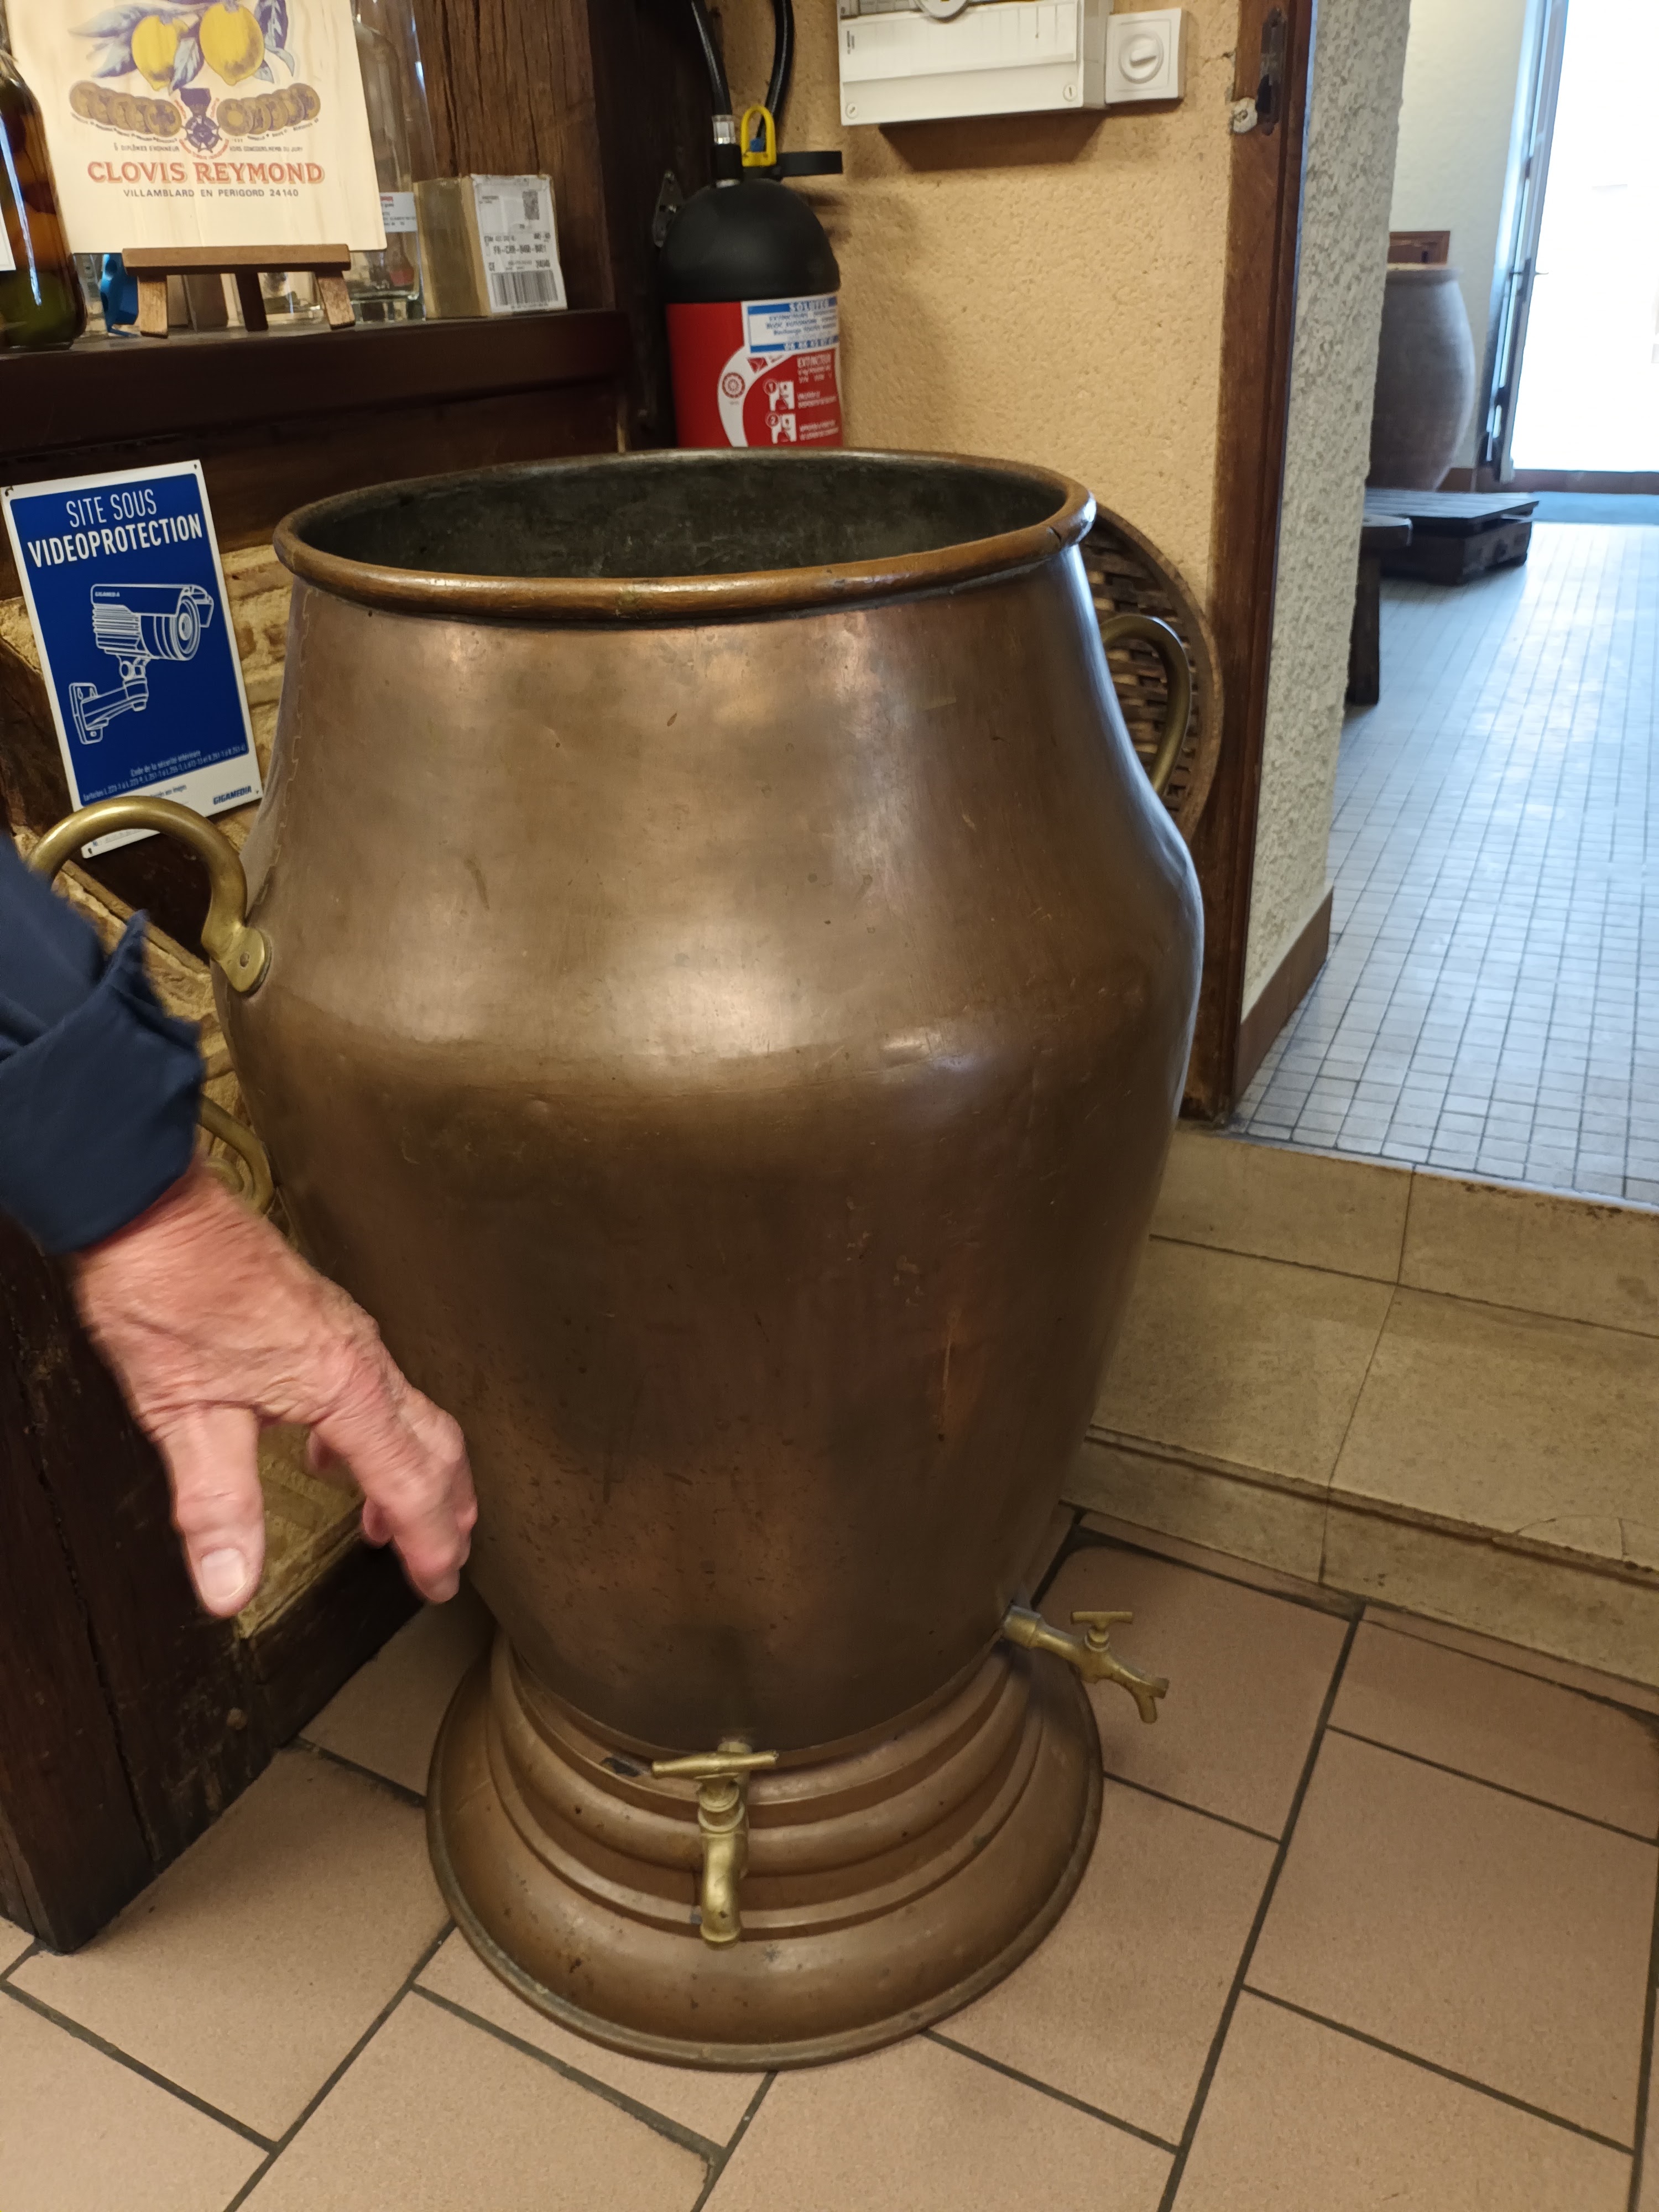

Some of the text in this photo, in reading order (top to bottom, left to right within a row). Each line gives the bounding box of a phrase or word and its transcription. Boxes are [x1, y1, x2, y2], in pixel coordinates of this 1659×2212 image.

[87, 161, 325, 185] CLOVIS REYMOND
[123, 189, 299, 197] VILLAMBLARD EN PERIGORD 24140
[66, 489, 157, 528] SITE SOUS
[27, 513, 203, 568] VIDEOPROTECTION
[213, 785, 252, 806] GIGAMEDIA
